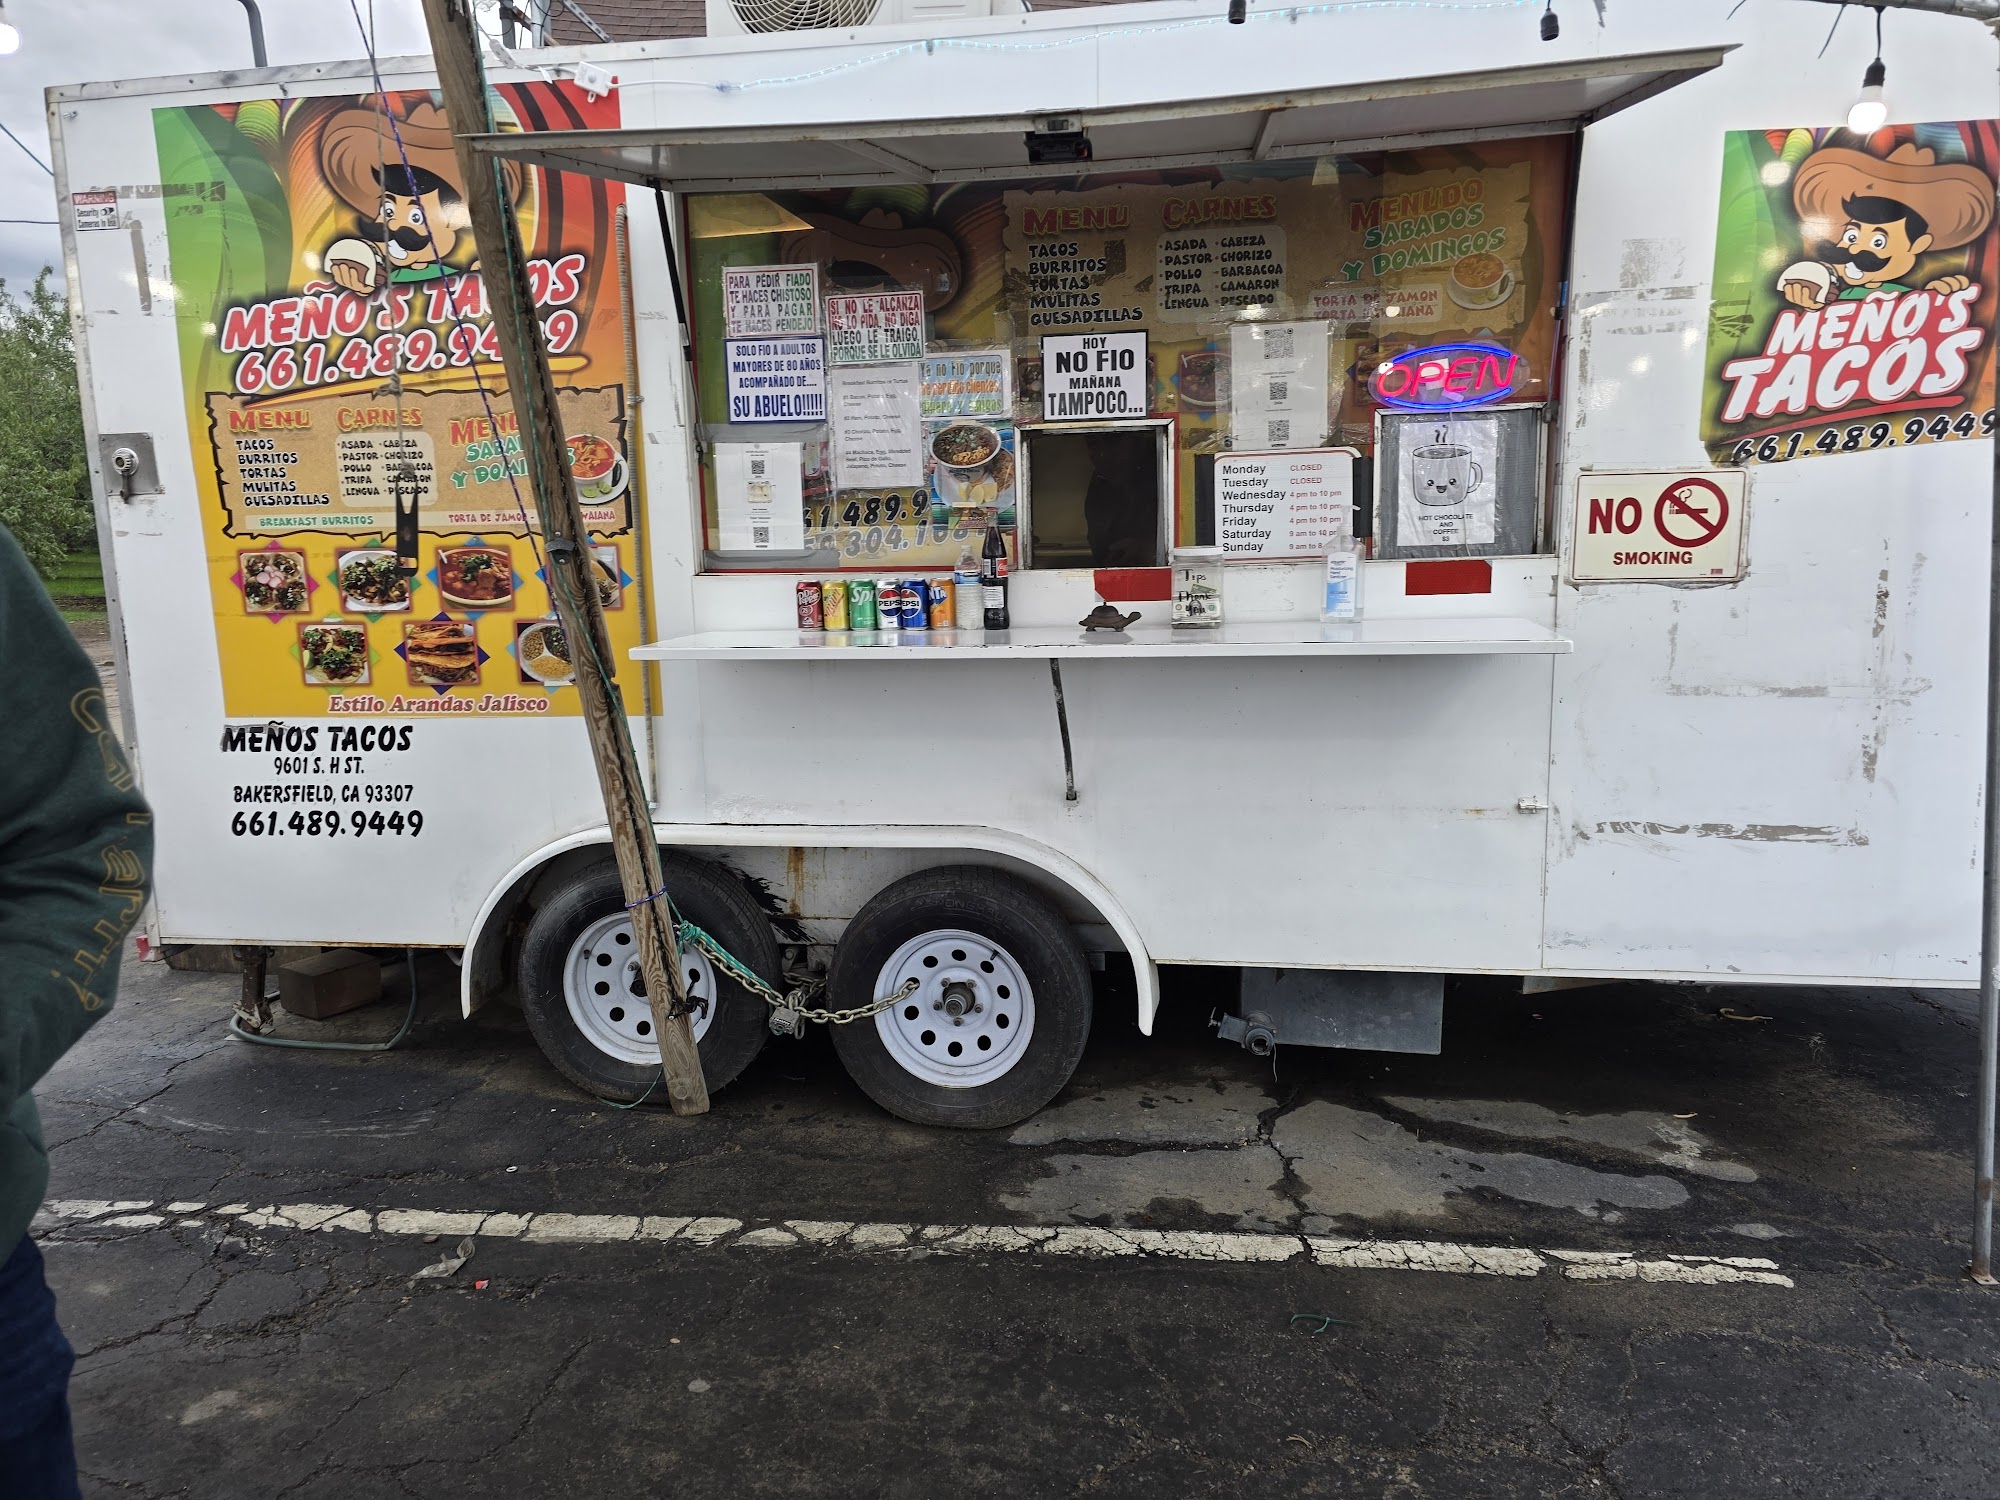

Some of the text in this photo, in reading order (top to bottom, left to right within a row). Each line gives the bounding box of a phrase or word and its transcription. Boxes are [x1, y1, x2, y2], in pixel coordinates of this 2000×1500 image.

[77, 208, 98, 218] Security
[1162, 194, 1276, 228] CARNES
[1351, 178, 1485, 232] MENUDO
[1023, 205, 1129, 235] MENU
[1364, 203, 1485, 249] SABADOS
[1029, 242, 1078, 258] TACOS
[1165, 235, 1265, 251] ASADA CABEZA
[1165, 250, 1272, 266] PASTOR CHORIZO
[1341, 227, 1505, 281] Y DOMINGOS
[1029, 258, 1106, 275] BURRITOS
[1165, 264, 1283, 280] POLLO BARBACOA
[423, 254, 586, 323] TAOS
[729, 276, 750, 289] PARA
[786, 273, 810, 286] FIADO
[1030, 275, 1090, 291] TORTAS
[1165, 279, 1279, 295] TRIPA CAMARON
[730, 288, 811, 303] TE HACES CHISTOSO
[1030, 292, 1100, 308] MULITAS
[1165, 294, 1274, 309] LENGUA PESCADO
[1314, 290, 1437, 307] TORTA JAMON
[731, 303, 812, 318] Y PARA PAGAR
[831, 296, 919, 315] SI NO LE ALCANZA
[847, 315, 857, 329] LO
[885, 313, 896, 327] NO
[900, 312, 920, 326] DIGA
[1031, 306, 1143, 326] QUESADILLAS
[1767, 284, 1980, 355] MEÑO'S
[731, 321, 741, 333] TE
[776, 318, 812, 331] PENDEJO
[833, 330, 878, 345] LUEGO LE
[1083, 337, 1106, 349] HOY
[236, 309, 578, 393] 661.489.949
[736, 343, 816, 356] SOLO FIO A ADULTOS
[833, 343, 920, 360] PORQUE SE LE OLVIDA
[733, 358, 820, 372] MAYORES DE 80 AÑOS
[1056, 349, 1134, 373] NO FIO
[739, 375, 794, 388] ACOMPAÑADO
[1069, 375, 1121, 389] MAÑANA
[1377, 354, 1517, 397] OPEN
[1725, 331, 1981, 419] TACOS
[734, 396, 750, 417] SU
[1048, 390, 1143, 416] TAMPOCO...
[228, 408, 312, 432] MENU
[342, 441, 373, 449] ASADA
[1733, 409, 1996, 465] 661.489.9449
[236, 439, 275, 452] TACOS
[238, 452, 298, 465] BURRITOS
[240, 466, 286, 480] TORTAS
[344, 464, 371, 472] POLLO
[1222, 465, 1266, 475] Monday
[243, 480, 297, 493] MULITAS
[345, 476, 372, 484] TRIPA
[1223, 479, 1268, 488] Tuesday
[346, 487, 380, 495] LENGUA
[1222, 490, 1286, 500] Wednesday
[245, 494, 330, 507] QUESADILLAS
[1222, 503, 1274, 513] Thursday
[260, 516, 374, 527] BREAKFAST BURRITOS
[449, 514, 491, 522] TORTA DE
[1223, 517, 1256, 526] Friday
[1588, 497, 1642, 534] NO
[1222, 530, 1271, 539] Saturday
[1223, 543, 1263, 552] Sunday
[1613, 551, 1692, 565] SMOKING
[1179, 569, 1206, 583] Tips
[329, 694, 549, 713] Estilo Arandas Jalisco
[221, 720, 413, 752] MEÑOS TACOS
[274, 757, 364, 775] 9601 S. H ST.
[234, 785, 413, 805] BAKERSFIELD, CA 93307
[232, 810, 423, 837] 661.489.9449
